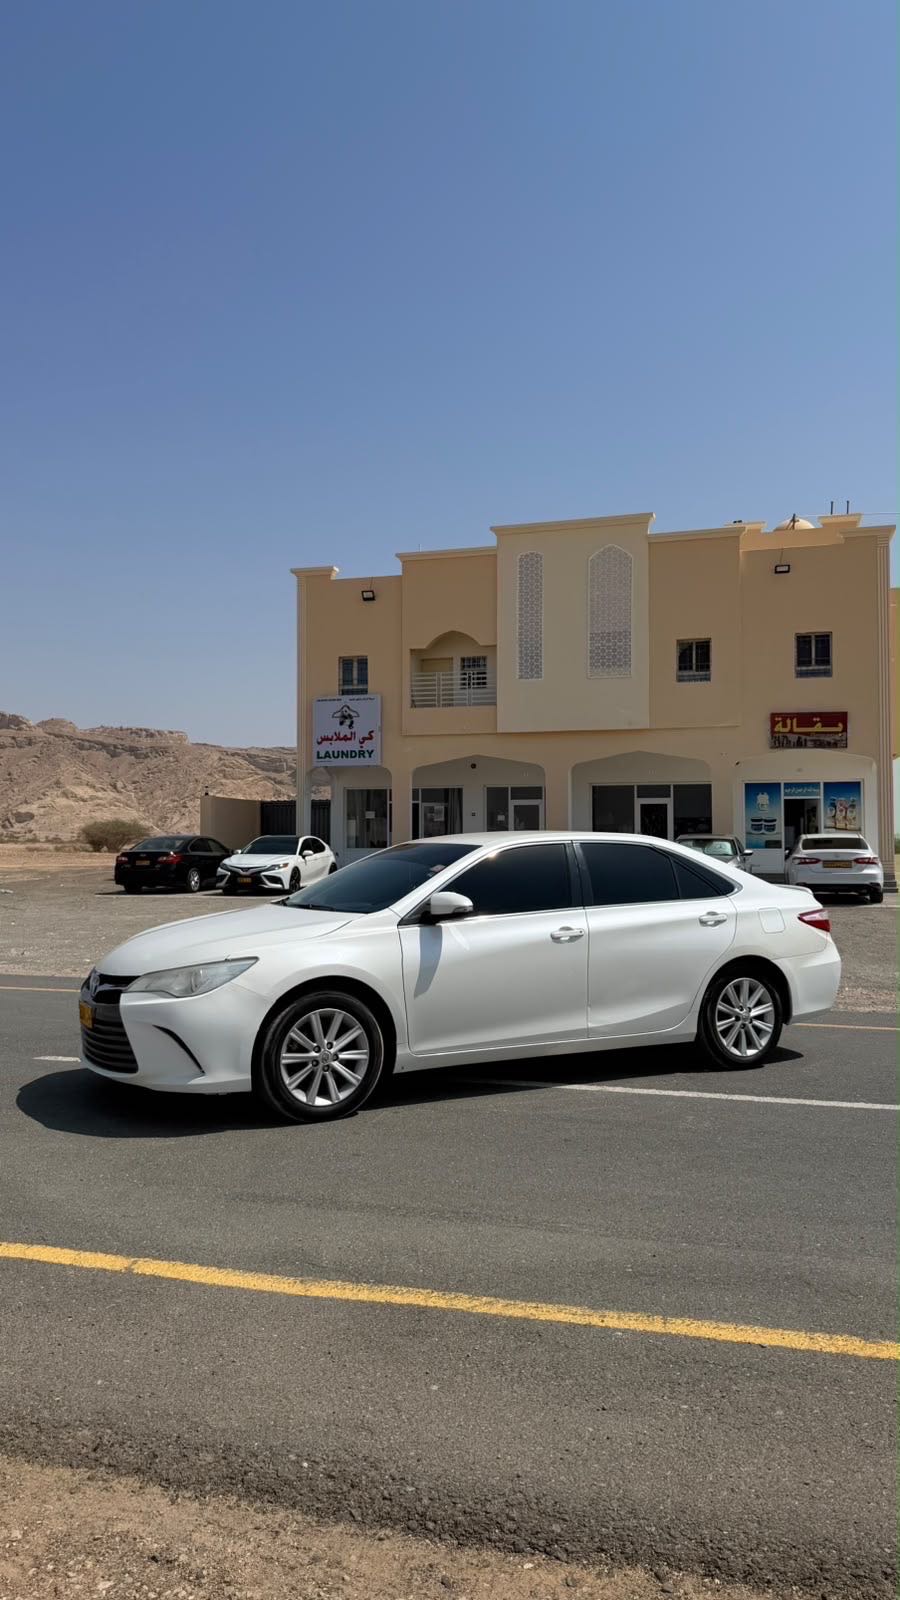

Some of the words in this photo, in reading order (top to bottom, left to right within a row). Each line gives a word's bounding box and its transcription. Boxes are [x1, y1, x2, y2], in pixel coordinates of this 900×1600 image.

[775, 717, 844, 736] بقالة
[316, 731, 356, 745] الملابس
[359, 730, 374, 748] كي
[316, 749, 374, 759] LAUNDRY
